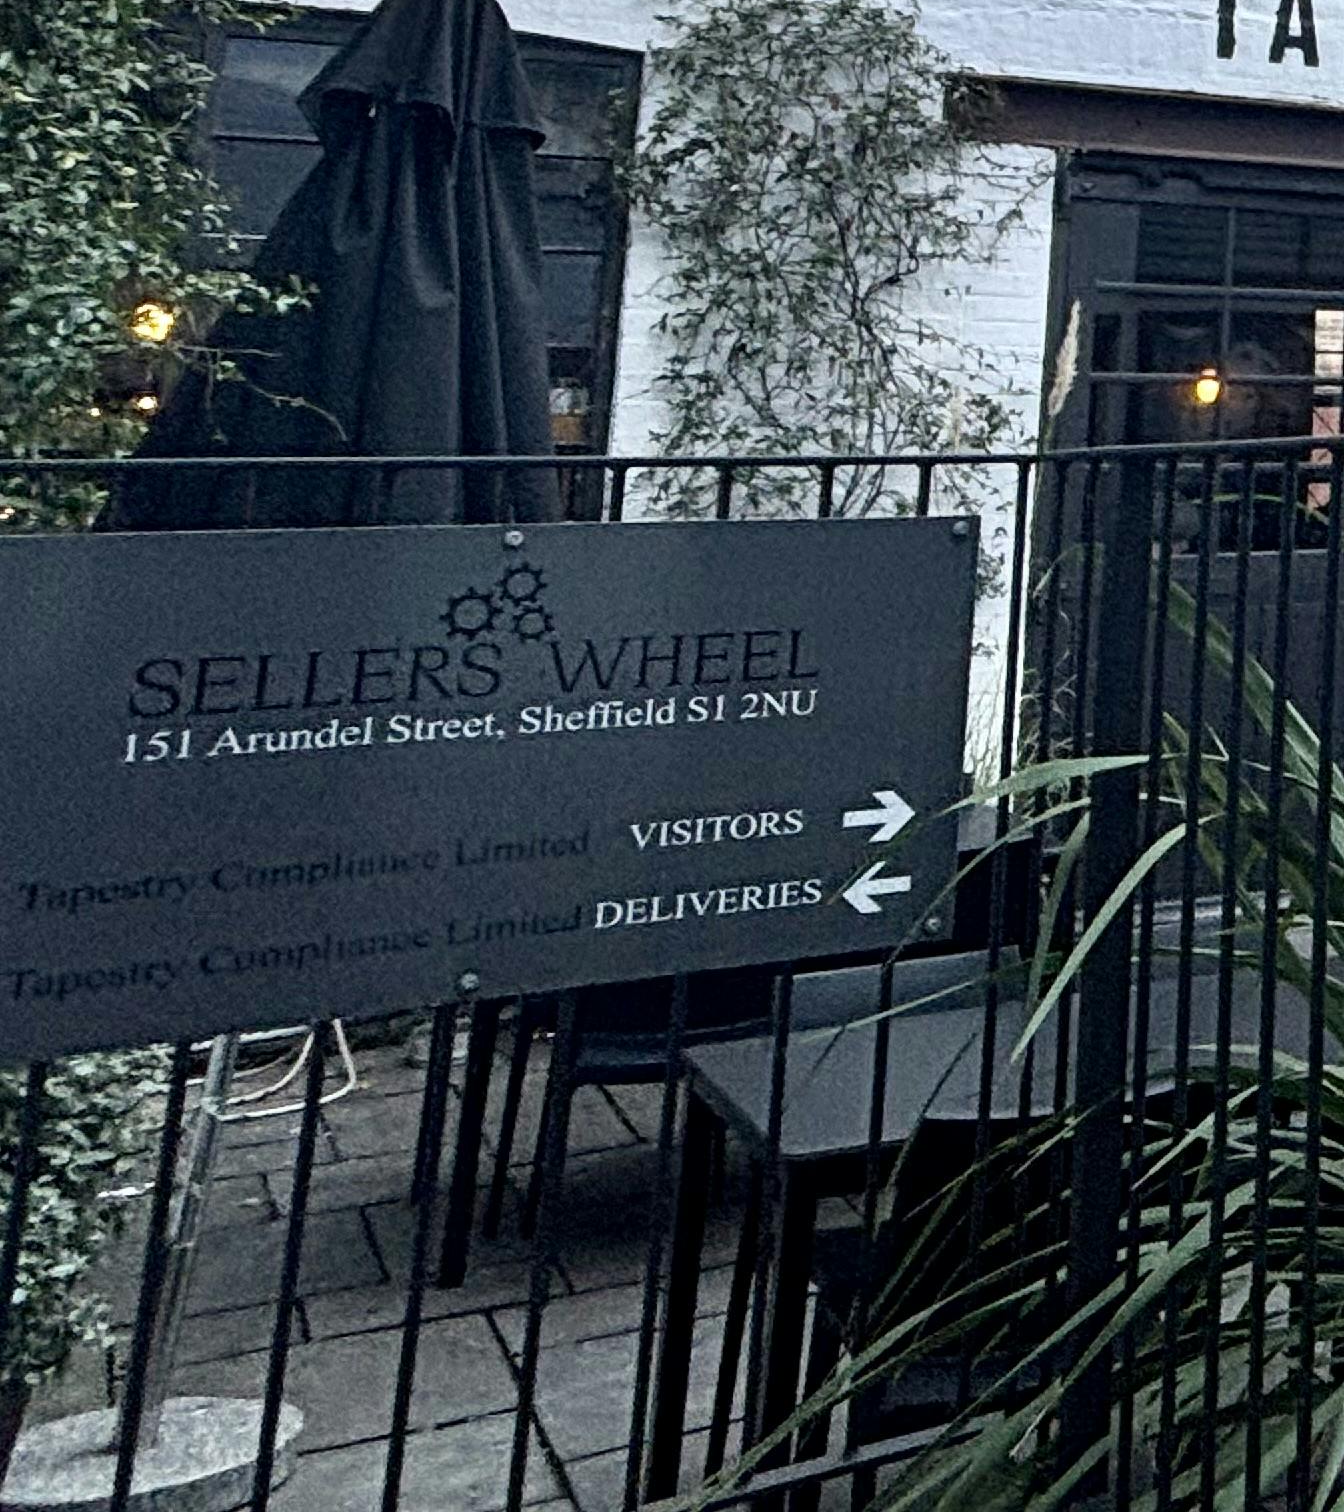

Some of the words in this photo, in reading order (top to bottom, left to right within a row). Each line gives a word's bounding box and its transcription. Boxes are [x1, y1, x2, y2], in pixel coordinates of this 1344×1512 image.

[129, 642, 502, 717] SELLERS
[548, 629, 820, 694] WHEEL
[124, 729, 192, 763] 151
[207, 716, 374, 757] Arundel
[518, 697, 676, 735] Sheffield
[688, 695, 726, 723] S1
[739, 689, 820, 720] 2NU
[630, 809, 804, 850] VISITORS
[594, 879, 822, 929] DELIVERIES
